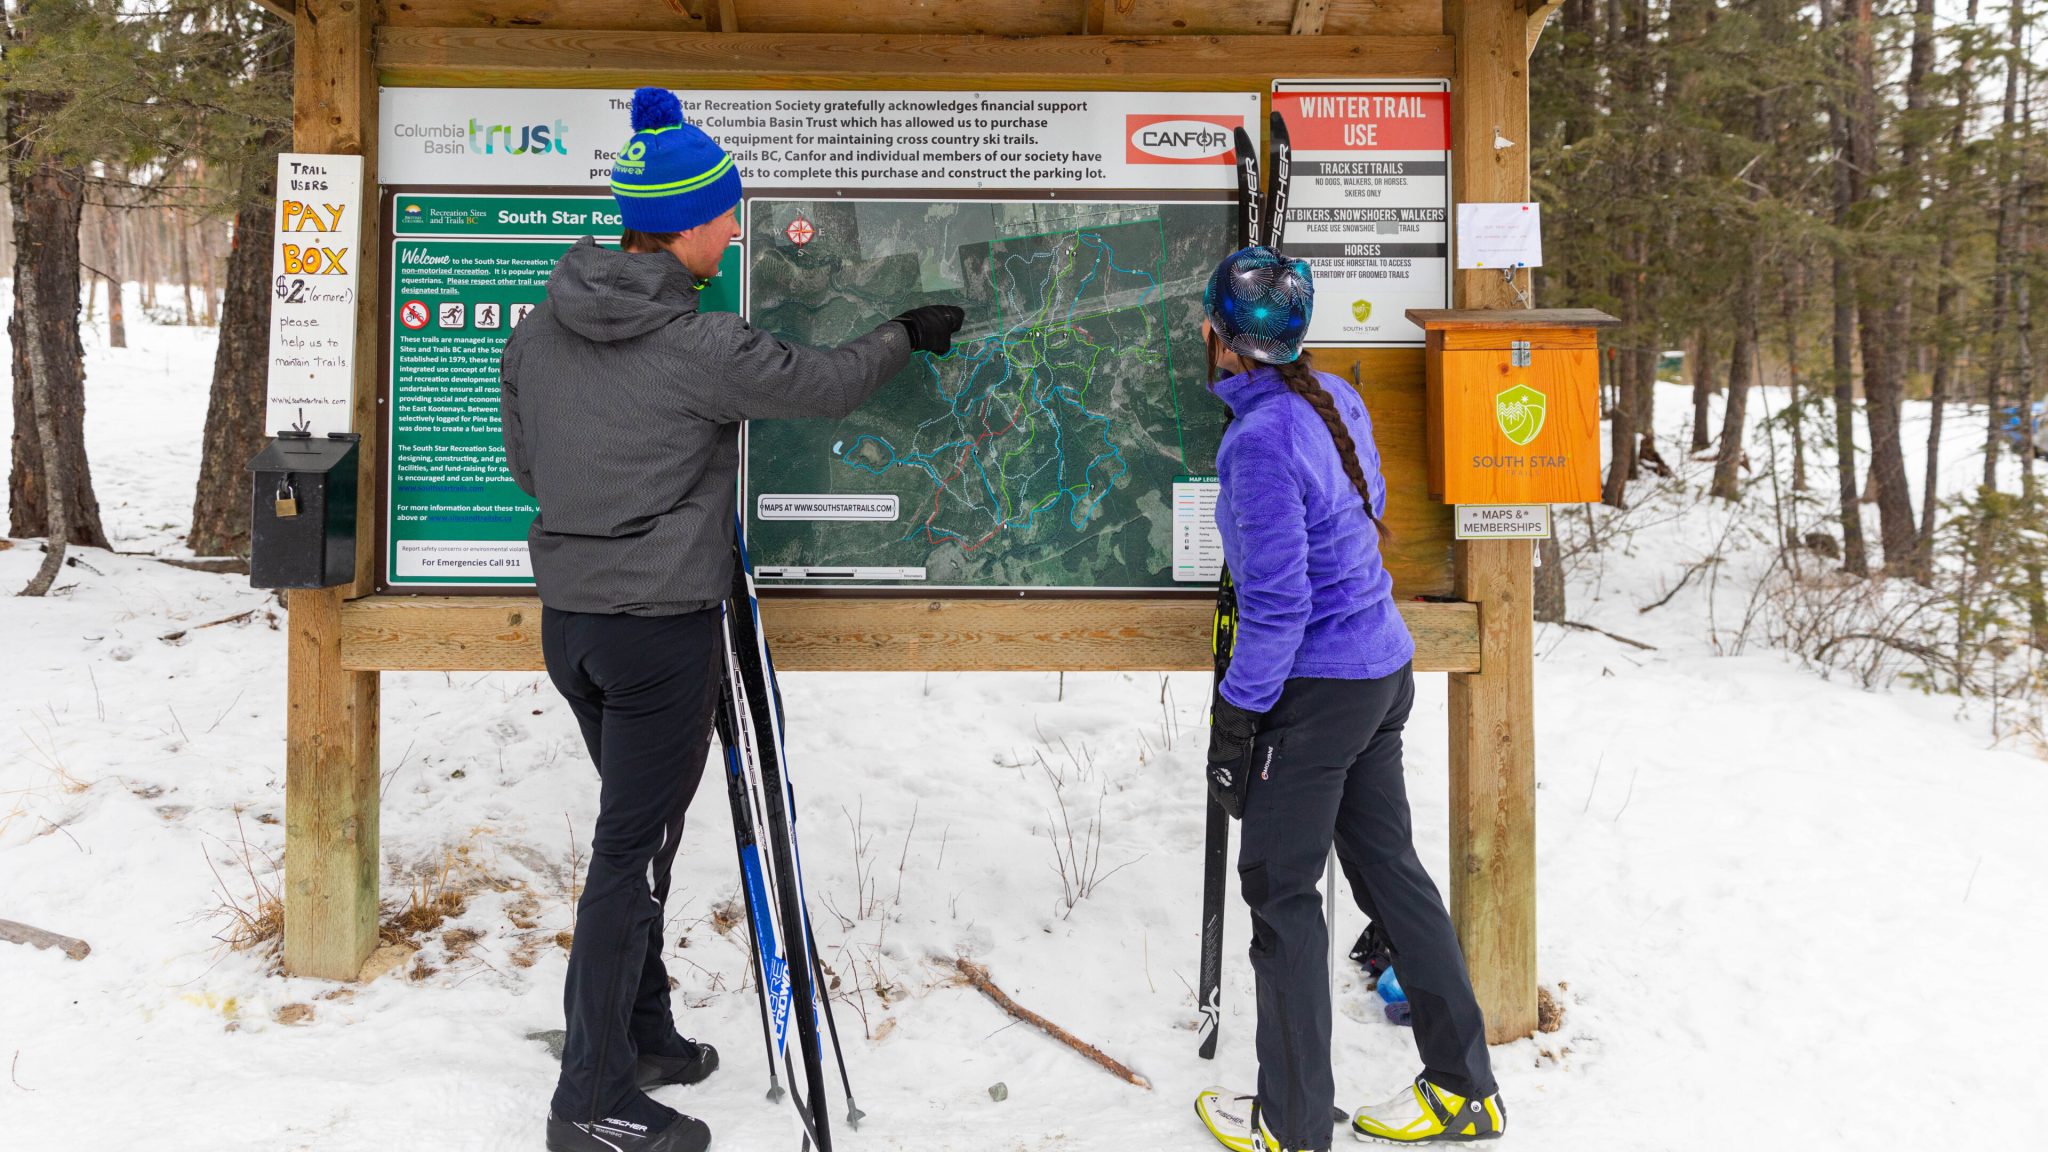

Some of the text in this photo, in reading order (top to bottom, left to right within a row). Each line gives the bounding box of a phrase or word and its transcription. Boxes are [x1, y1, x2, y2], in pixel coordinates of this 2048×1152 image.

[609, 99, 631, 110] The
[704, 100, 771, 110] Recreation
[775, 100, 820, 113] Society
[824, 100, 884, 113] gratefully
[888, 100, 977, 113] acknowledges
[980, 100, 1033, 110] financial
[1037, 101, 1087, 113] support
[1300, 96, 1425, 118] WINTER TRAIL
[394, 123, 464, 137] Columbia
[706, 116, 765, 127] Columbia
[770, 116, 802, 127] Basin
[805, 117, 837, 127] Trust
[840, 116, 876, 127] which
[881, 116, 901, 127] has
[905, 116, 953, 127] allowed
[974, 118, 987, 127] to
[991, 117, 1047, 130] purchase
[469, 118, 568, 155] trust
[724, 133, 792, 146] equipment
[796, 133, 814, 144] for
[817, 133, 892, 146] maintaining
[931, 135, 979, 146] country
[983, 133, 999, 144] ski
[1003, 133, 1038, 144] trails.
[1143, 130, 1226, 149] CANFOR
[1344, 124, 1376, 145] USE
[424, 140, 464, 153] Basin
[761, 150, 780, 162] BC,
[784, 150, 826, 160] Canfor
[829, 150, 852, 160] and
[856, 150, 919, 161] individual
[923, 150, 981, 161] members
[984, 150, 997, 160] of
[1025, 150, 1068, 164] society
[1072, 150, 1101, 161] have
[757, 168, 770, 177] to
[773, 167, 831, 180] complete
[834, 167, 857, 177] this
[861, 167, 918, 180] purchase
[921, 167, 944, 177] and
[948, 168, 1006, 177] construct
[1010, 167, 1030, 177] the
[1034, 167, 1081, 180] parking
[1086, 167, 1105, 178] lot.
[1320, 162, 1402, 173] TRACK SET TRAILS
[282, 200, 345, 232] PAY
[498, 210, 546, 223] South
[552, 211, 586, 224] Star
[1286, 209, 1444, 221] AT BIKERS, SNOWSHOERS, WALKERS
[401, 248, 449, 264] Welcome
[1344, 244, 1380, 255] HORSES
[282, 243, 348, 274] BOX
[280, 316, 319, 332] please
[281, 334, 305, 350] help
[328, 338, 338, 347] to
[1472, 456, 1566, 468] SOUTH STAR
[1482, 510, 1522, 519] MAPS &
[1464, 522, 1541, 532] MEMBERSHIPS
[437, 558, 486, 567] Emergencies
